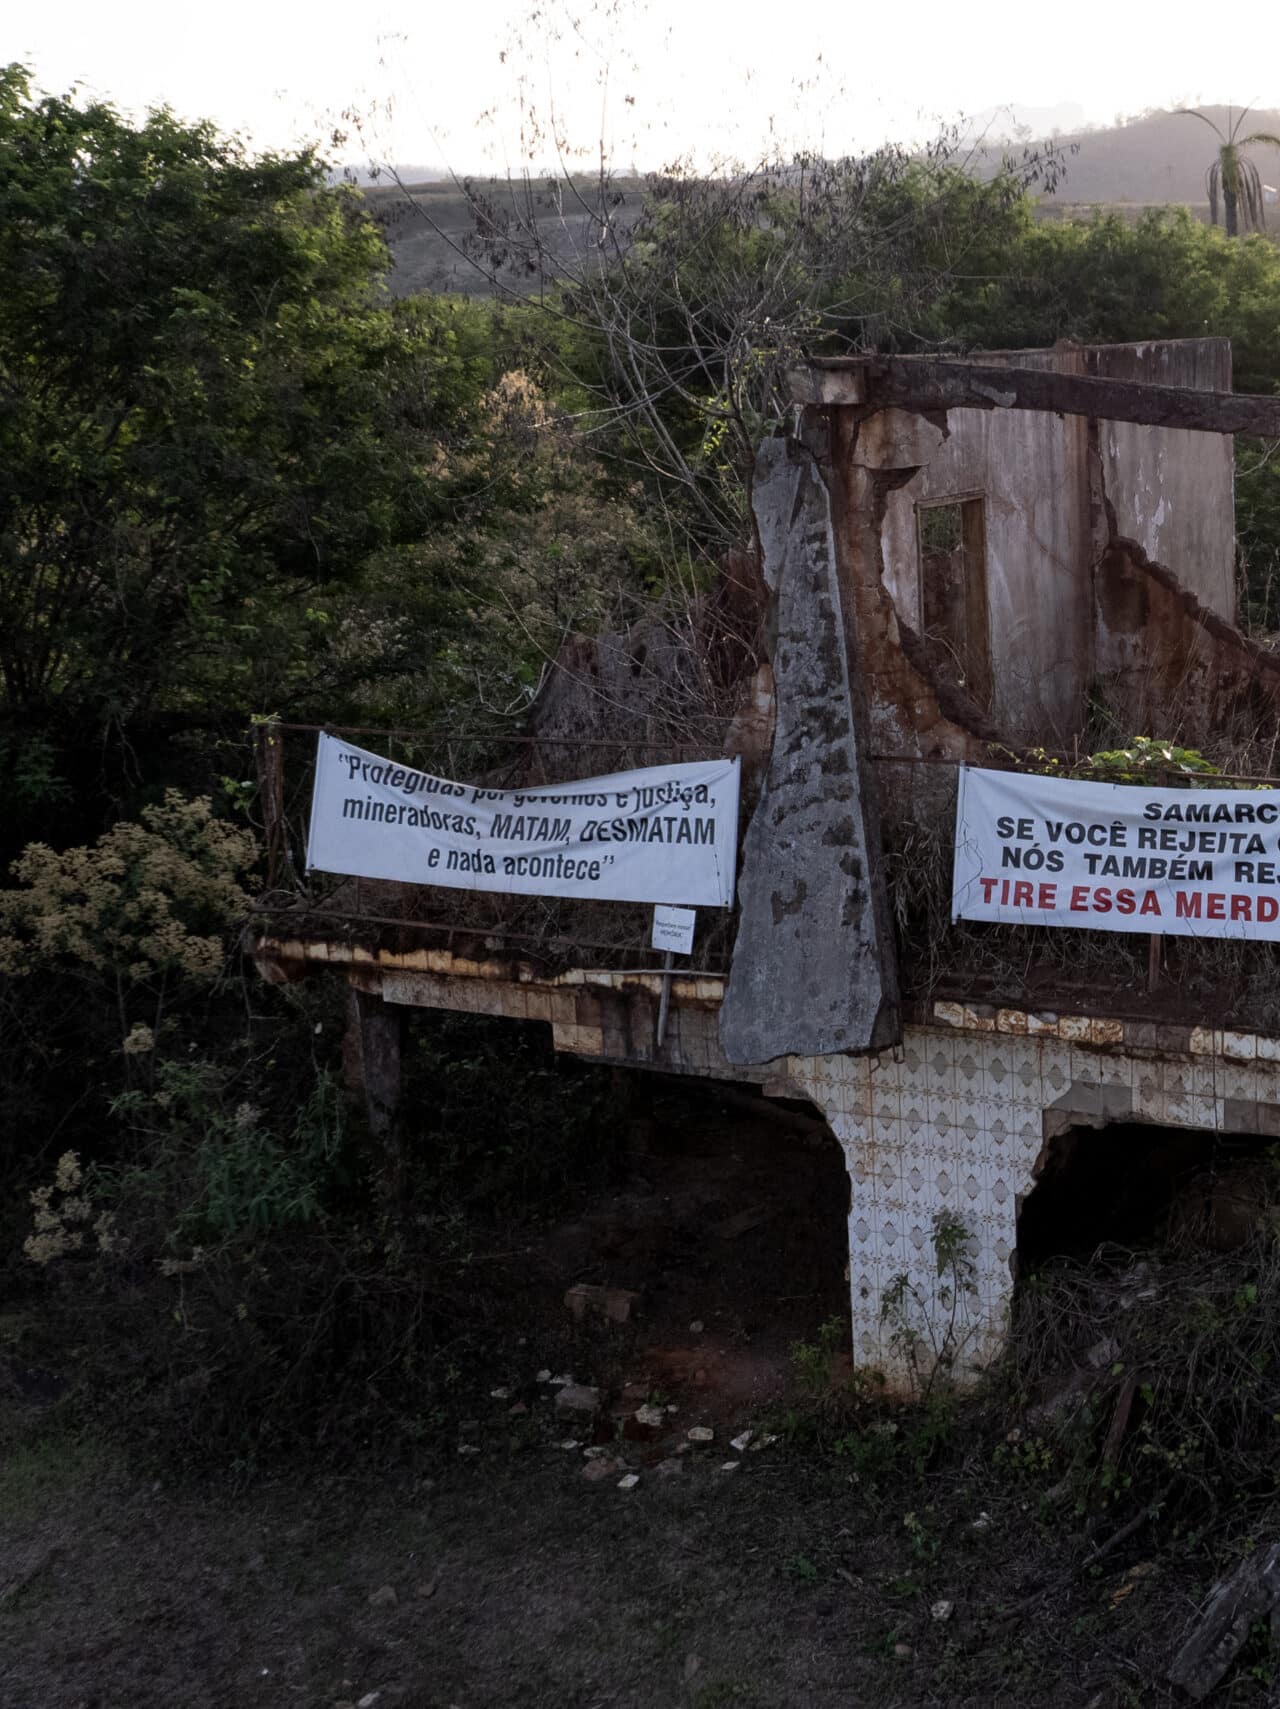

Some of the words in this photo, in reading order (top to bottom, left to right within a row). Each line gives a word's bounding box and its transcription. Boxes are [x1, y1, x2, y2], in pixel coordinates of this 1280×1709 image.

[343, 796, 481, 840] mineradoras,
[489, 814, 572, 846] MATAM,
[579, 817, 716, 846] DESMATAM
[996, 816, 1035, 841] SE
[1044, 819, 1128, 848] VOCÊ
[1138, 827, 1267, 855] REJEITA
[427, 848, 441, 868] e
[446, 849, 498, 874] nada
[1001, 842, 1065, 873] NÓS
[1083, 852, 1214, 882] TAMBÉM
[979, 877, 1059, 910] TIRE
[1069, 885, 1162, 917] ESSA
